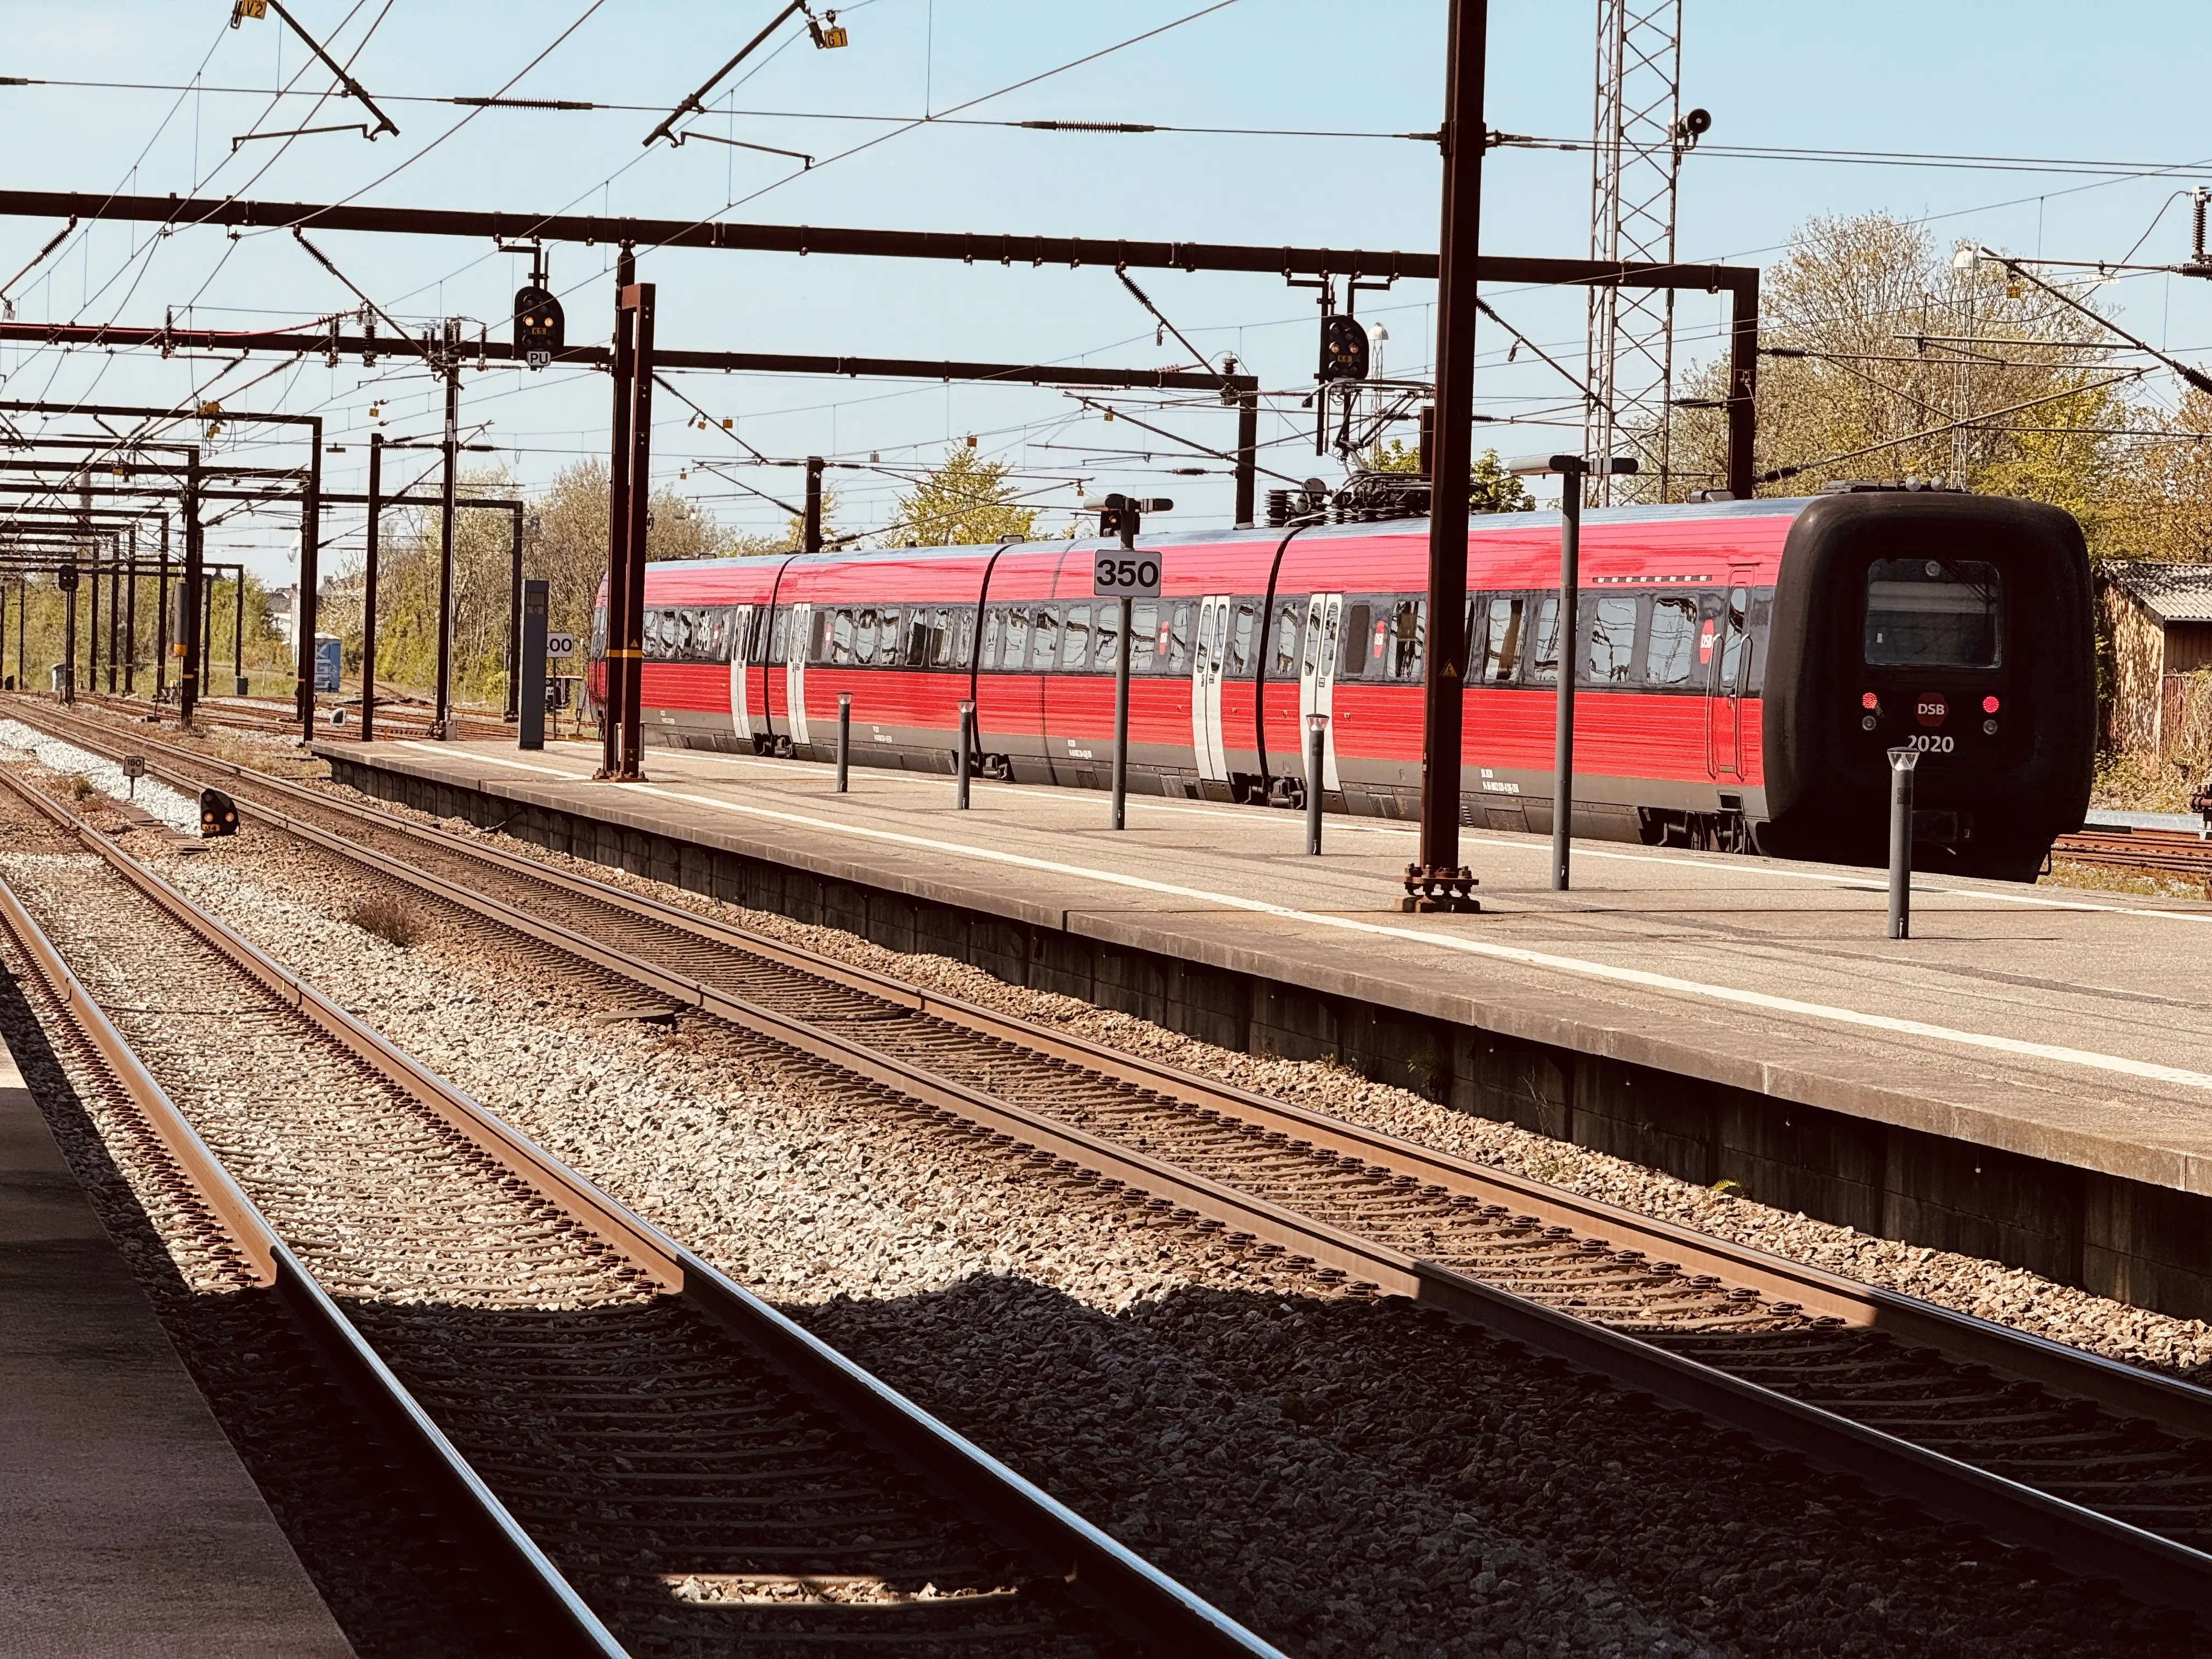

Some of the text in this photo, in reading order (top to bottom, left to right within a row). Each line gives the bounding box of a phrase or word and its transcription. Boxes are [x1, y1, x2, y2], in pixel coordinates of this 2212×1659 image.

[247, 3, 263, 16] V2
[530, 353, 549, 364] PU
[1096, 559, 1159, 588] 350
[546, 638, 572, 652] 00
[1701, 635, 1713, 648] DSB
[1917, 703, 1945, 715] DSB
[1908, 735, 1954, 753] 2020
